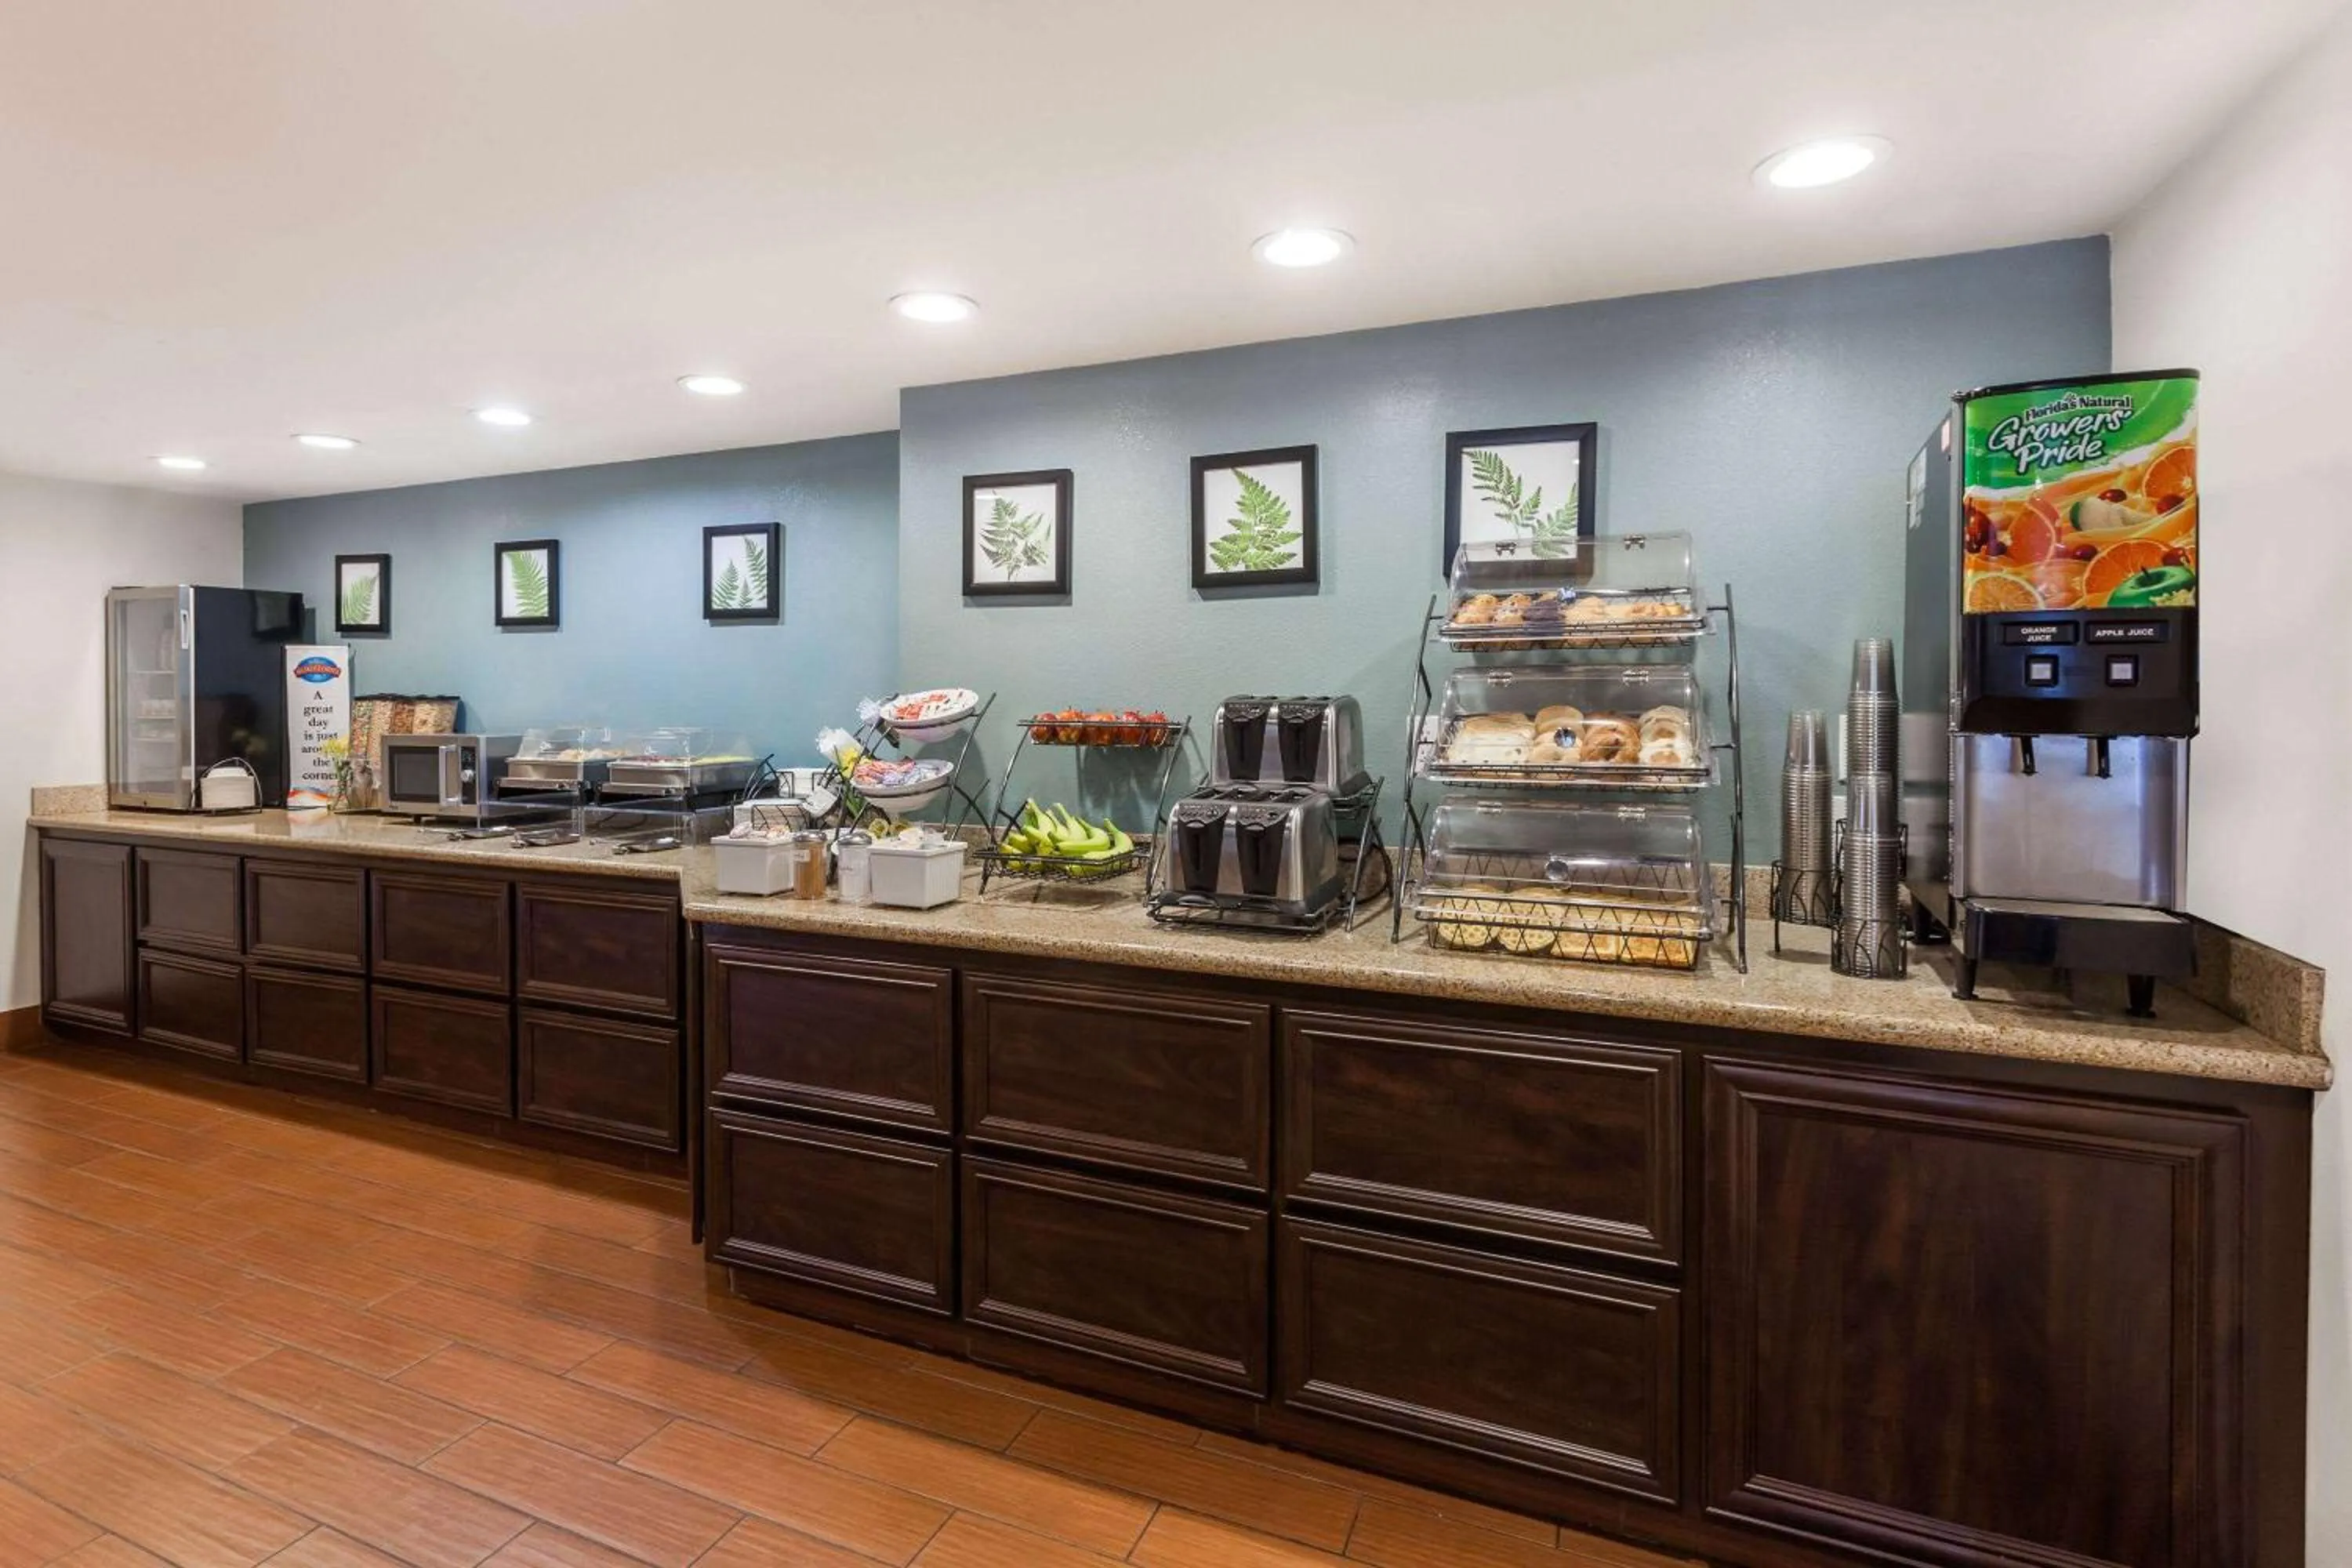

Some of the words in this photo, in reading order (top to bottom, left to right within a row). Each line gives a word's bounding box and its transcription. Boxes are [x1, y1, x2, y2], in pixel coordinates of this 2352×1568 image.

[2079, 396, 2130, 408] Natural
[2013, 433, 2103, 474] Pride
[2127, 628, 2154, 637] JUICE
[314, 691, 323, 700] A
[303, 706, 333, 717] great
[308, 717, 327, 730] day
[303, 730, 314, 741] is
[316, 730, 338, 742] just
[313, 757, 330, 767] the
